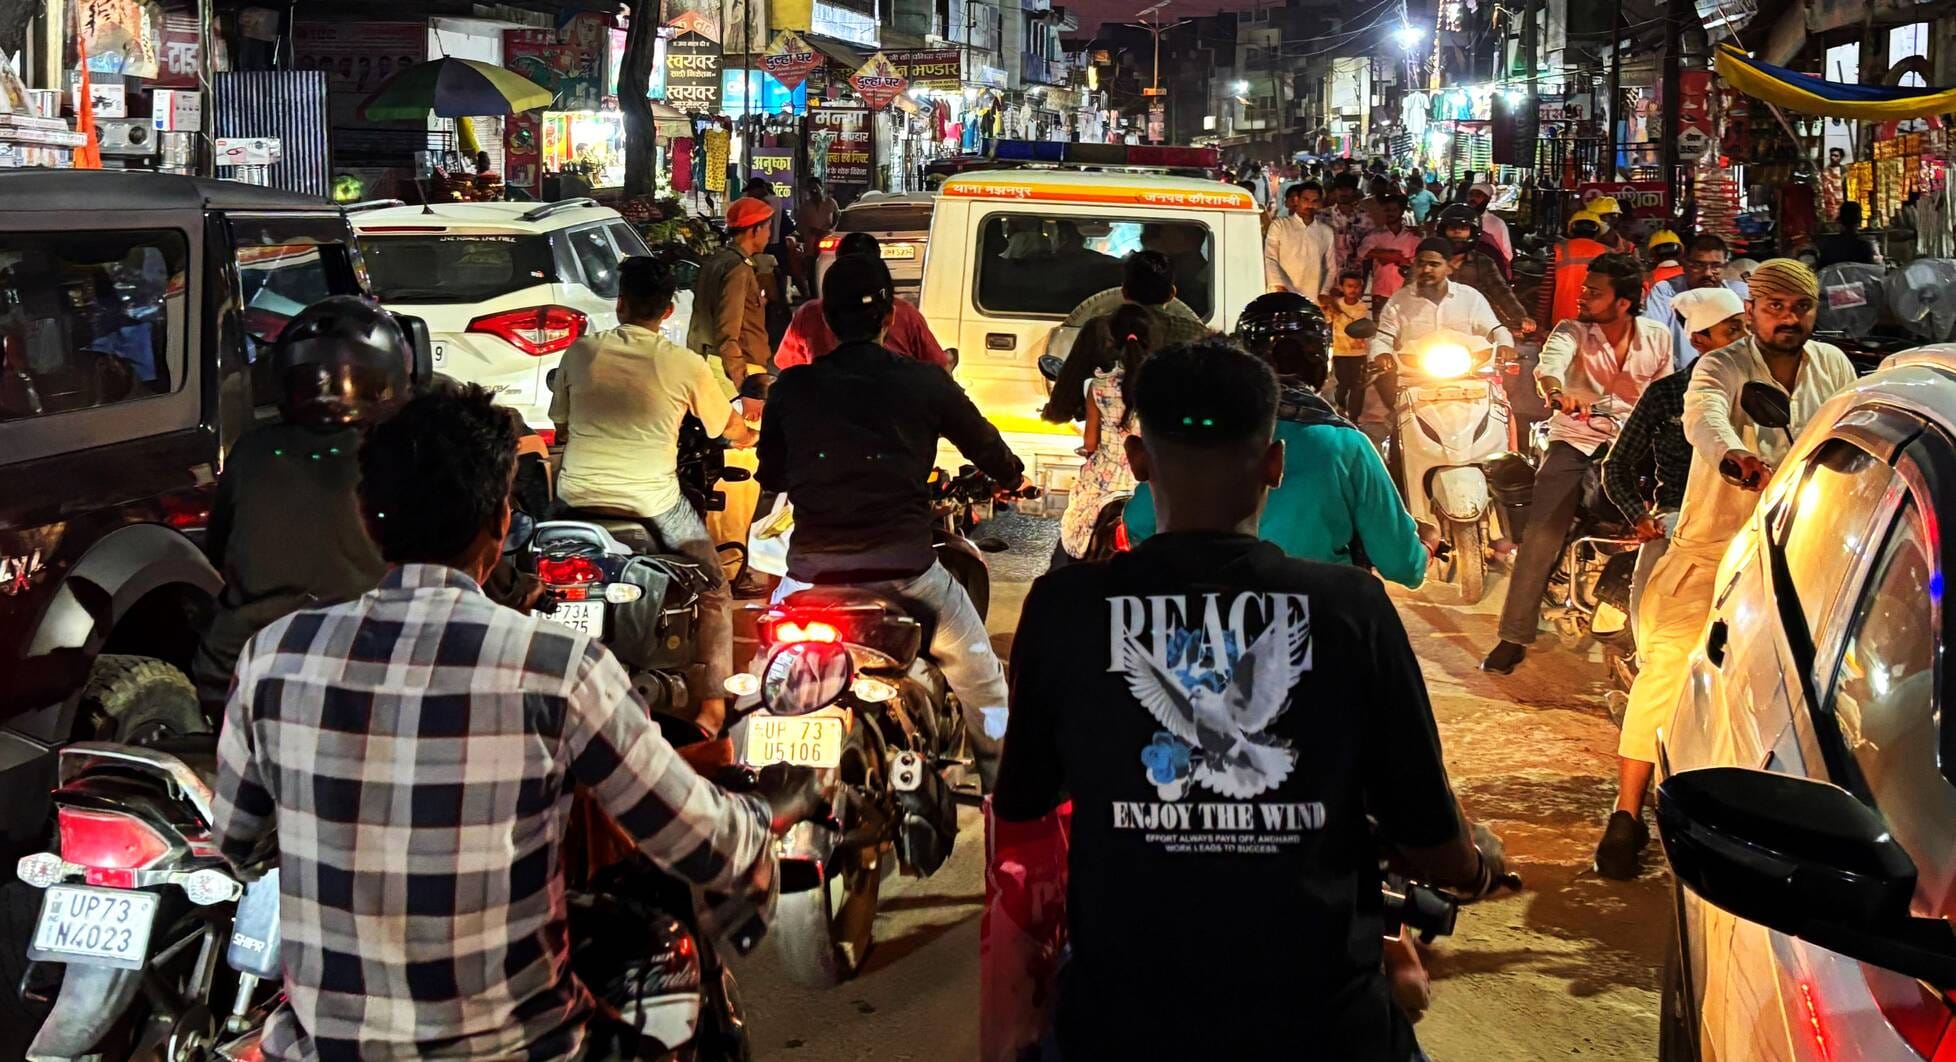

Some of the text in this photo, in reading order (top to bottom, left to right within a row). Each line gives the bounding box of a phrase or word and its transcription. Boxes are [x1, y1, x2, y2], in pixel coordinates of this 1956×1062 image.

[1105, 590, 1314, 674] PEACE
[765, 720, 823, 740] UP 73
[763, 742, 821, 762] U5106
[1112, 801, 1326, 831] ENJOY THE WIND
[1145, 834, 1178, 843] EFFORT
[1179, 834, 1214, 843] ALWAYS
[1214, 834, 1237, 843] PAYS
[1165, 844, 1193, 852] WORK
[1193, 844, 1223, 852] LEADS
[1223, 844, 1236, 852] TO
[70, 893, 132, 923] UP73
[55, 921, 133, 952] N4023
